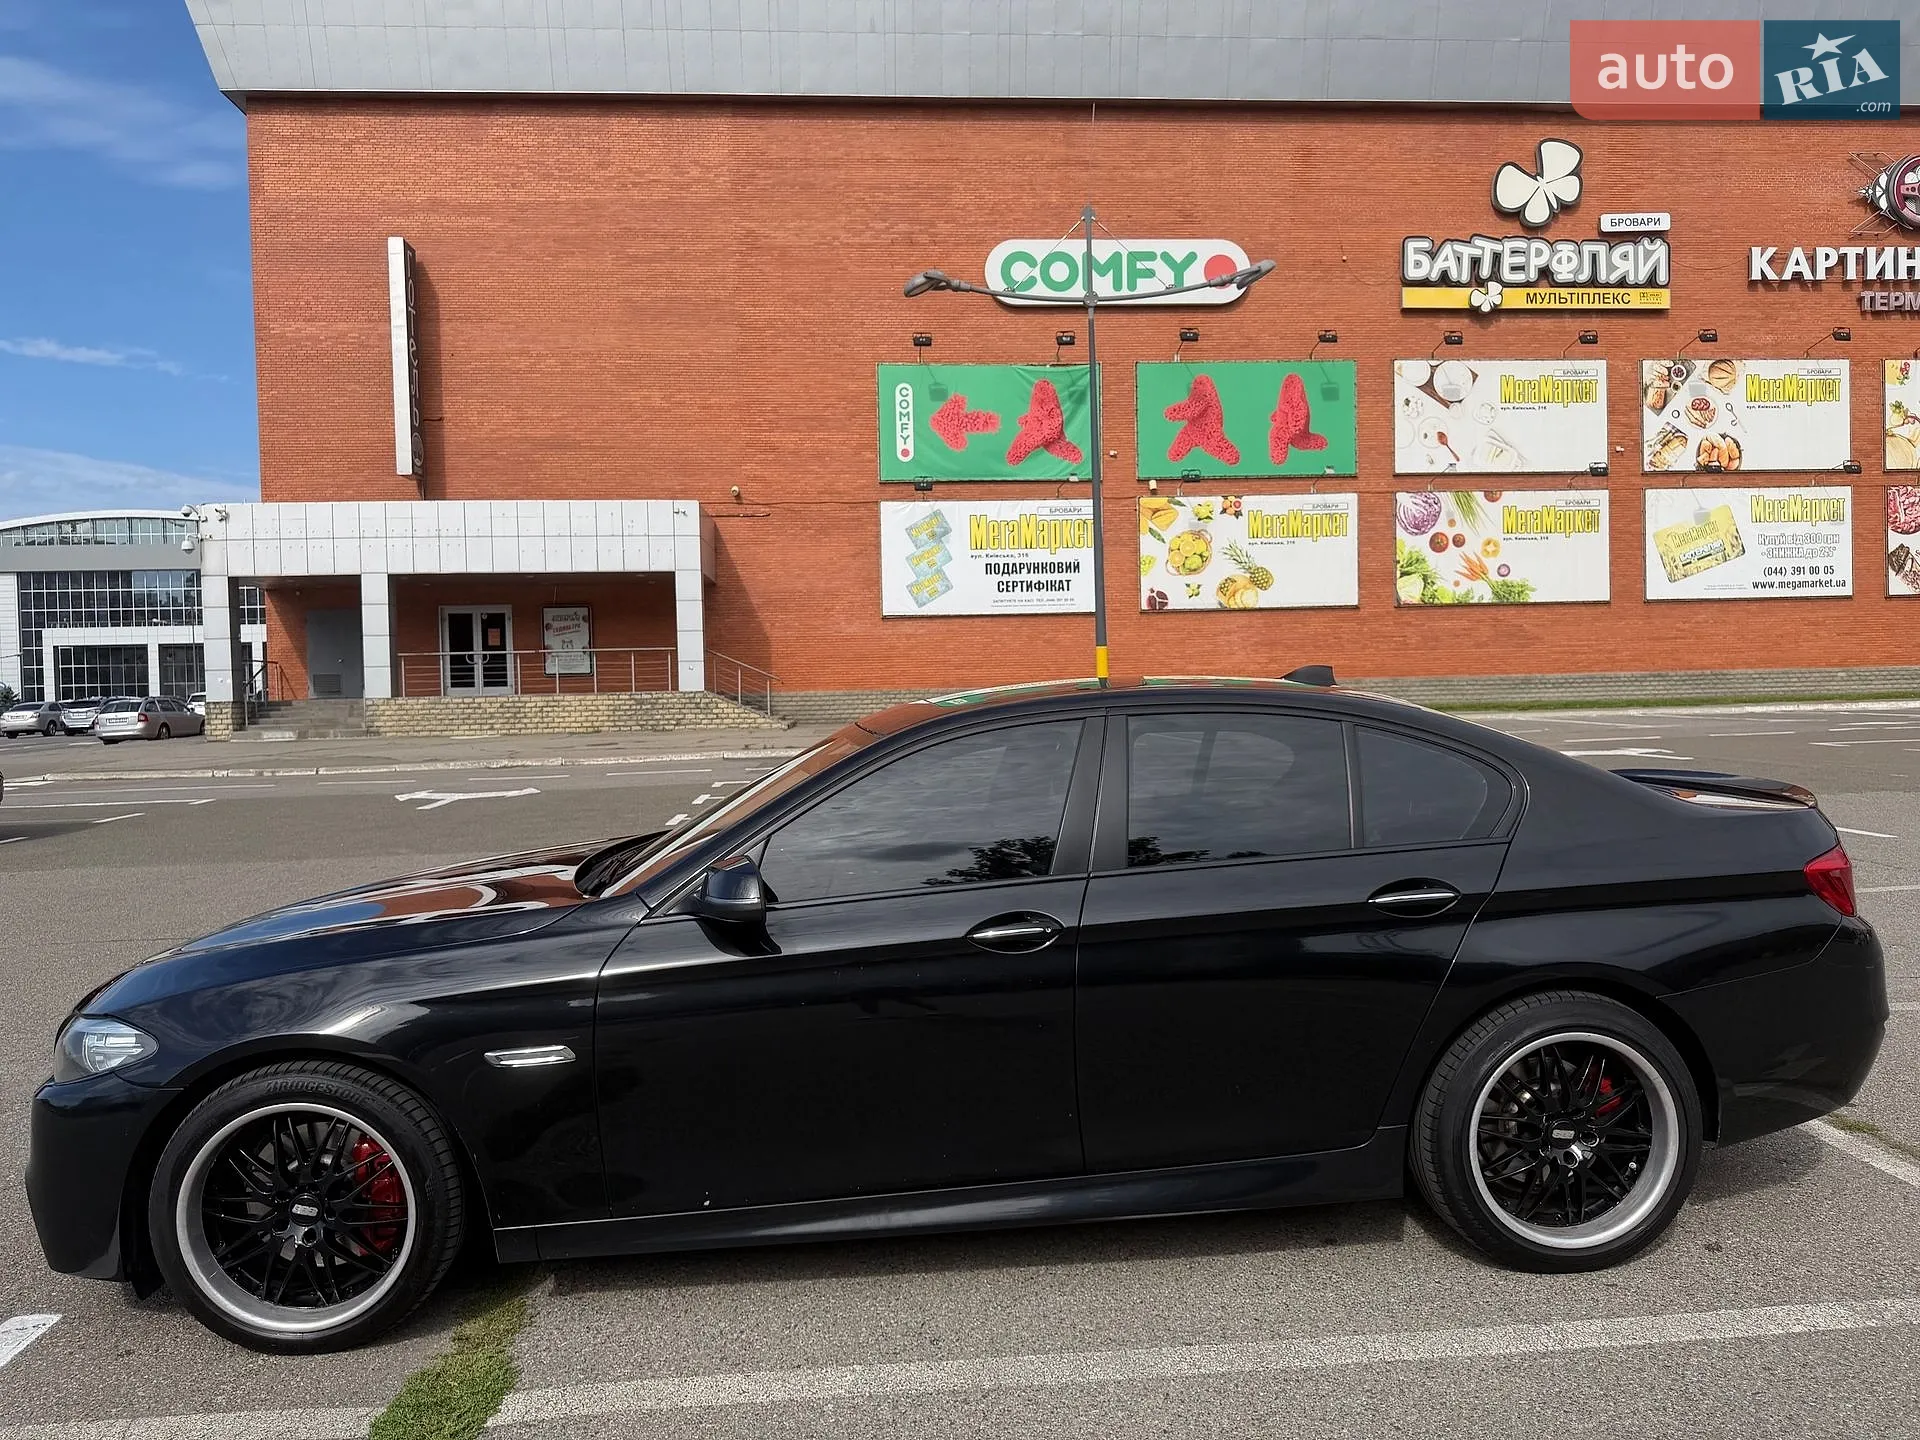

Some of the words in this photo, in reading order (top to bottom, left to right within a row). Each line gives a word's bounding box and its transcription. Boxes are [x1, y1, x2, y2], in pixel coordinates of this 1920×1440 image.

[1610, 217, 1661, 227] БРОВАРИ
[1001, 250, 1197, 292] COMFY
[1402, 235, 1670, 286] БАТТЕРФЛЯЙ
[1750, 246, 1920, 280] КАРТИН
[1526, 292, 1631, 305] МУЛЬТІПЛЕКС
[1500, 374, 1598, 408] МегаМаркет
[1746, 374, 1841, 406] МегаМаркет
[899, 386, 911, 446] COMFY
[1048, 507, 1083, 515] БРОВАРИ
[1248, 509, 1348, 542] МегаМаркет
[1503, 505, 1600, 538] МегаМаркет
[1751, 494, 1845, 526] МегаМаркет
[969, 514, 1094, 555] МегаМаркет
[1804, 532, 1823, 545] 300
[985, 559, 1080, 576] ПОДАРУНКОВИЙ
[1763, 566, 1787, 577] (044)
[1791, 566, 1806, 575] 391
[1809, 566, 1820, 575] 00
[1823, 565, 1835, 575] 05
[997, 580, 1072, 593] СЕРТИФІКАТ
[1752, 578, 1846, 590] www.megamarket.ua
